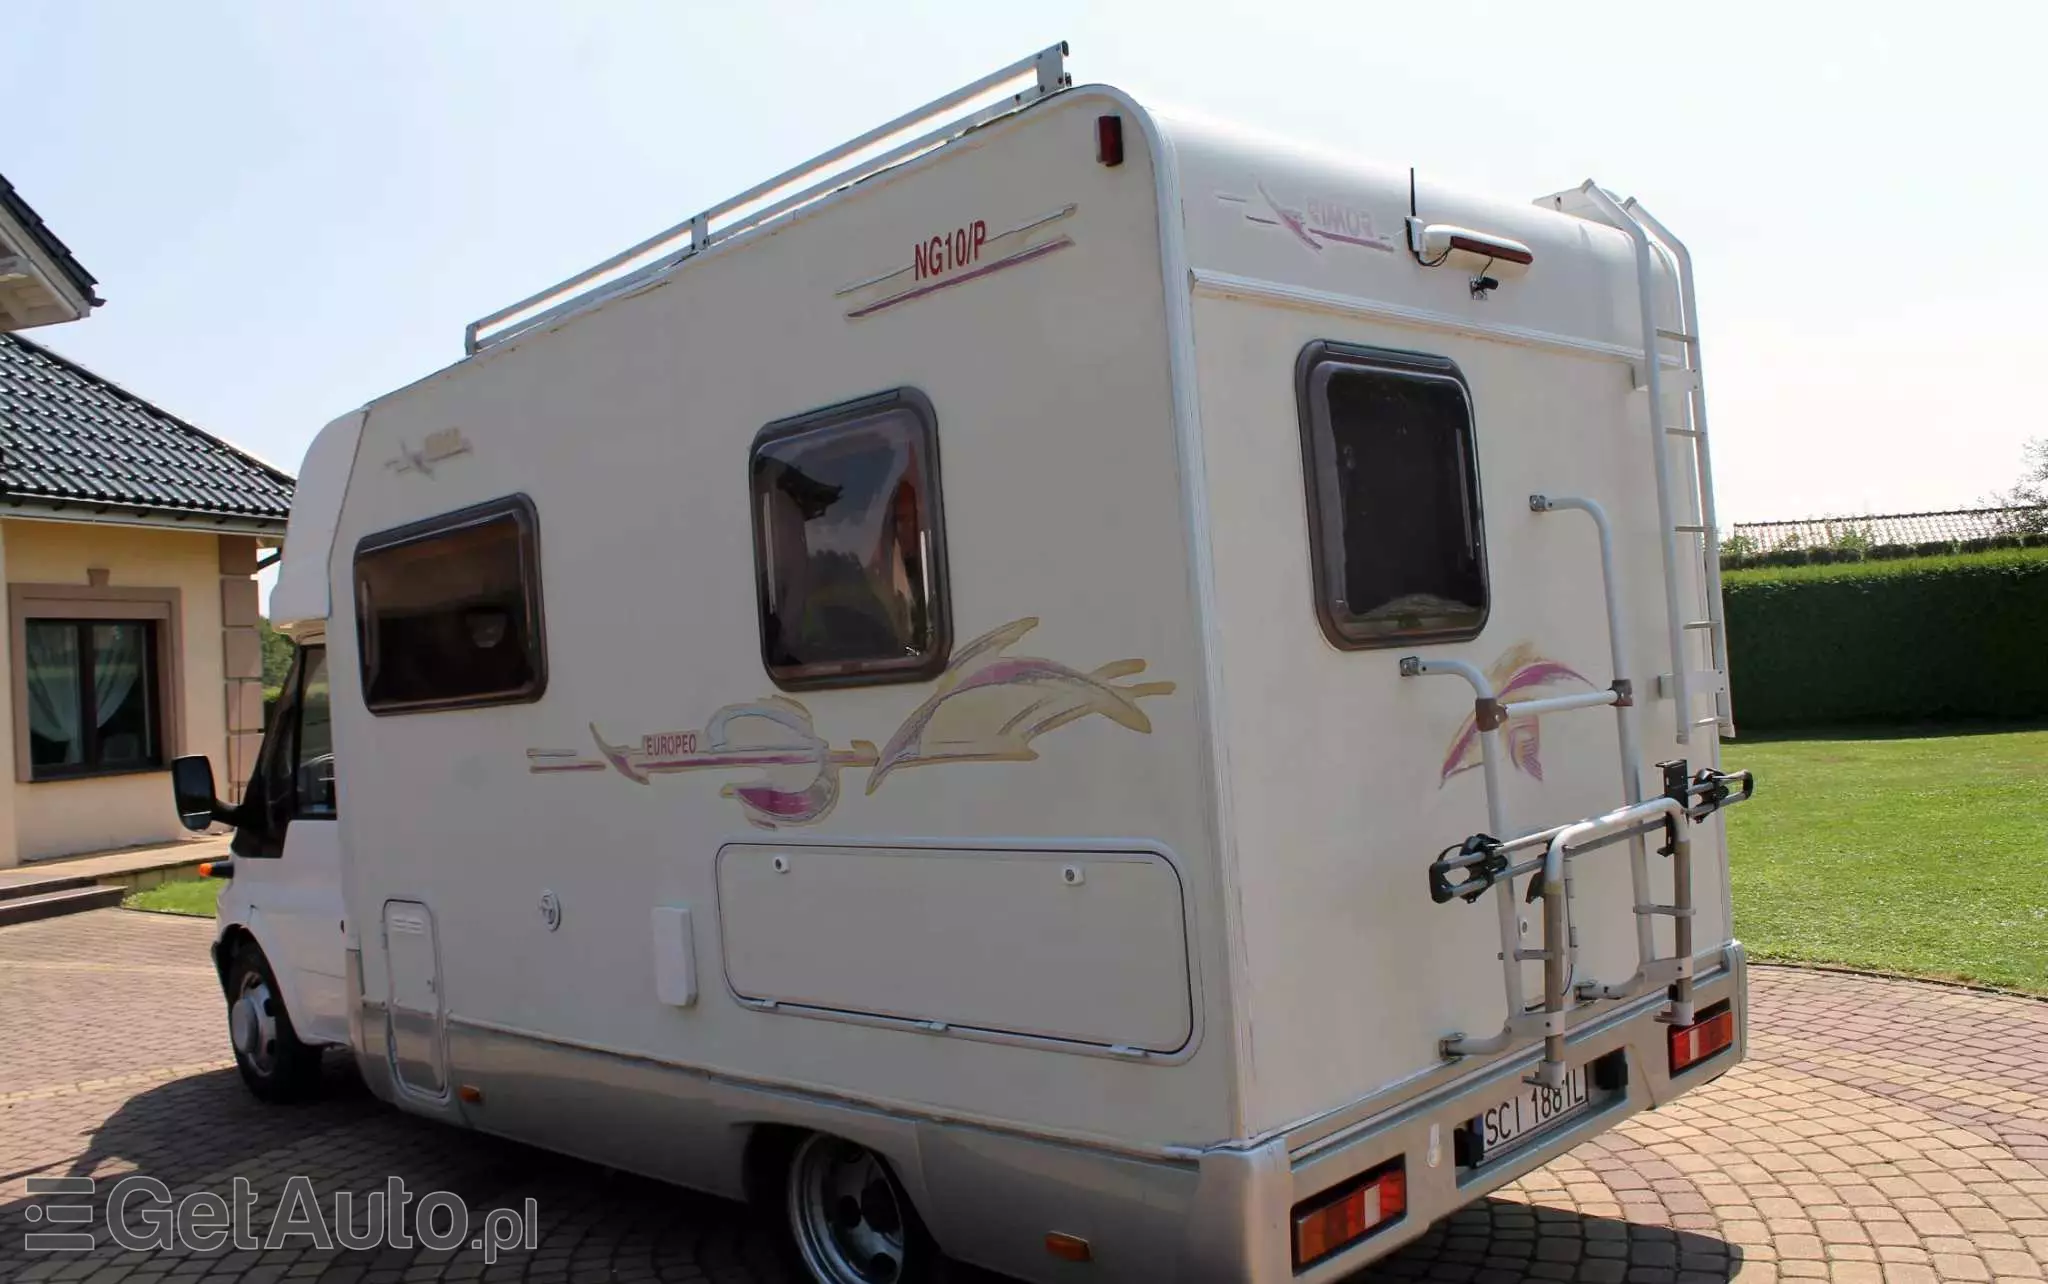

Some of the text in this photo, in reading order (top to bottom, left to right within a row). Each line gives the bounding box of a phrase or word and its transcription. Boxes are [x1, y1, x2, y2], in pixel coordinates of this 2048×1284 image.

[915, 220, 986, 281] NG10/P
[646, 733, 697, 756] EUROPEO
[1485, 1096, 1520, 1146] SCI
[1531, 1068, 1583, 1124] 1881L
